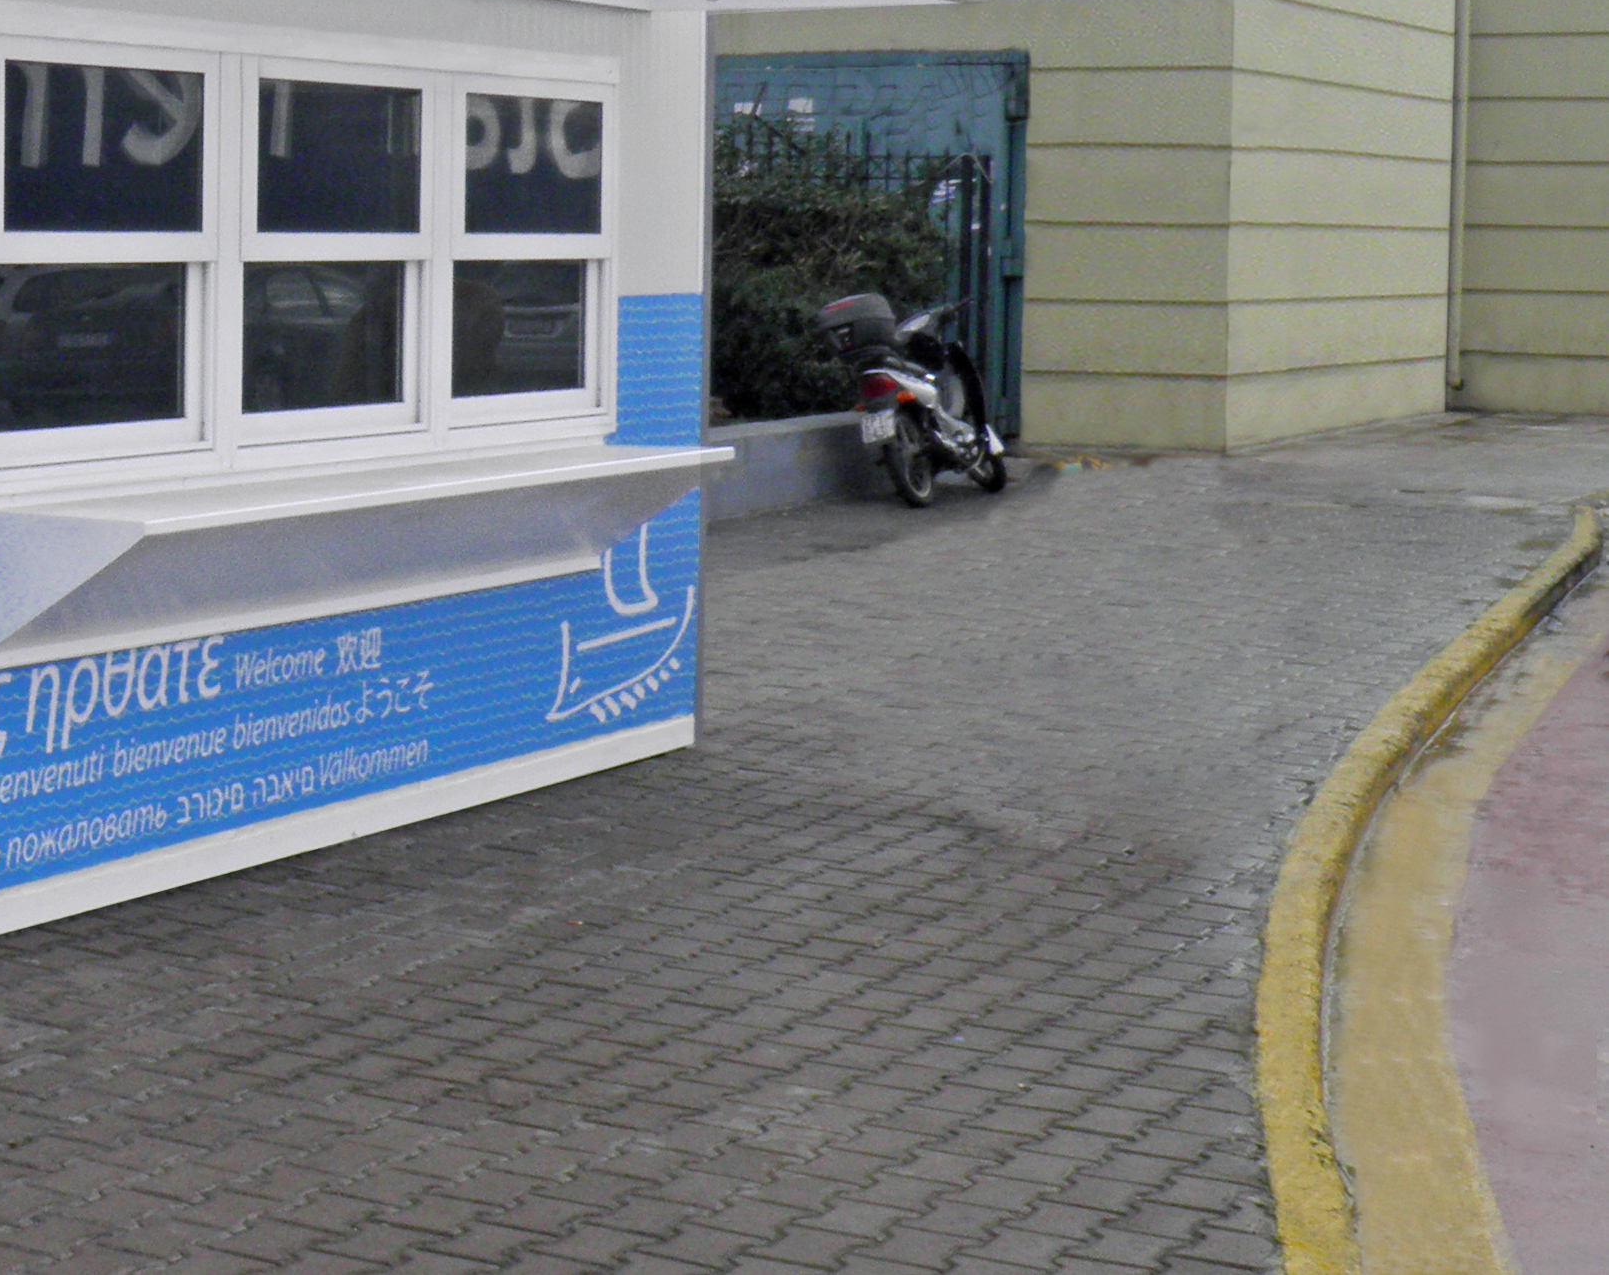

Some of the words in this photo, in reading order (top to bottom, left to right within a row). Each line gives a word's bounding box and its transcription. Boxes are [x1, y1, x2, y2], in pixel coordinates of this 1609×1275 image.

[235, 646, 327, 689] Welcome
[113, 726, 226, 778] bienvenue
[232, 694, 351, 750] bienvenidos
[319, 739, 428, 787] Välkommen
[5, 802, 168, 867] пожаловать
